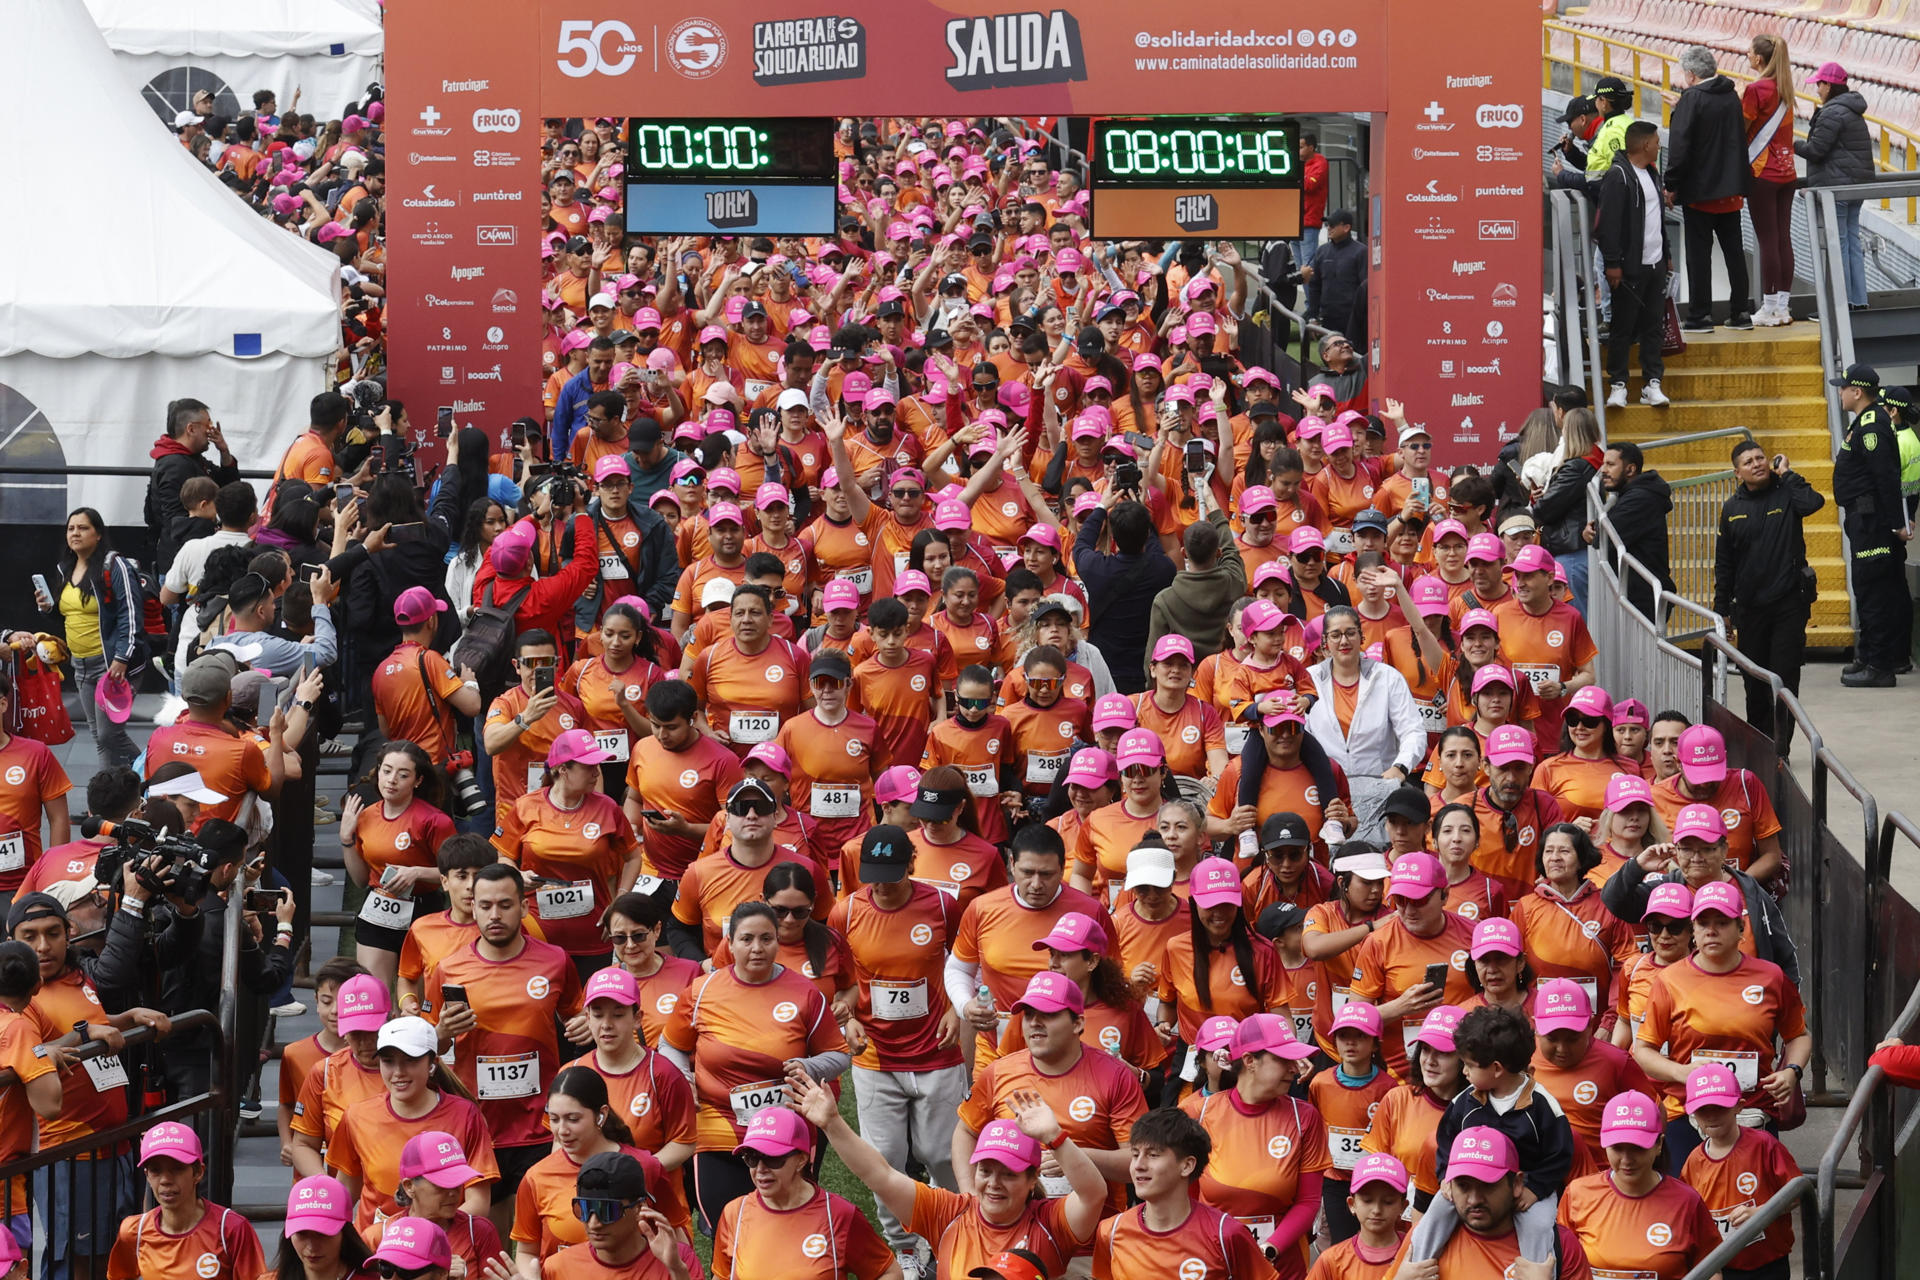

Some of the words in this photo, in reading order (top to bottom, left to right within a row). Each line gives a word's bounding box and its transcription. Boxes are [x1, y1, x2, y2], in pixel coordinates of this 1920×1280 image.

[827, 18, 836, 30] DE
[754, 19, 826, 49] CARRERA
[827, 29, 836, 42] LA
[1135, 30, 1292, 48] @solidaridadxcol
[557, 20, 636, 77] 50
[617, 43, 643, 53] AÑOS
[946, 11, 1072, 78] SALIDA
[754, 42, 859, 77] SOLIDARIDAD
[1135, 54, 1357, 71] www.caminatadelasolidaridad.com
[442, 79, 490, 93] Patrocinan:
[1446, 75, 1493, 88] Patrocinan:
[477, 115, 516, 127] FRUCO
[1481, 110, 1518, 122] FRUCO
[402, 198, 456, 207] Colsubsidio
[706, 190, 750, 220] 10KM
[1406, 194, 1458, 202] Colsubsidio
[1176, 194, 1211, 224] 5KM
[451, 265, 485, 282] Apoyan:
[1452, 259, 1486, 276] Apoyan:
[492, 304, 516, 312] Sencia
[482, 343, 509, 351] Acinpro
[1482, 338, 1509, 346] Acinpro
[452, 398, 486, 413] Aliados:
[1451, 392, 1484, 407] Aliados:
[738, 719, 770, 730] 1120
[823, 792, 849, 804] 481
[546, 889, 584, 905] 1021
[373, 897, 401, 914] 930
[888, 991, 910, 1004] 78
[488, 1063, 528, 1081] 1137
[740, 1088, 784, 1109] 1047
